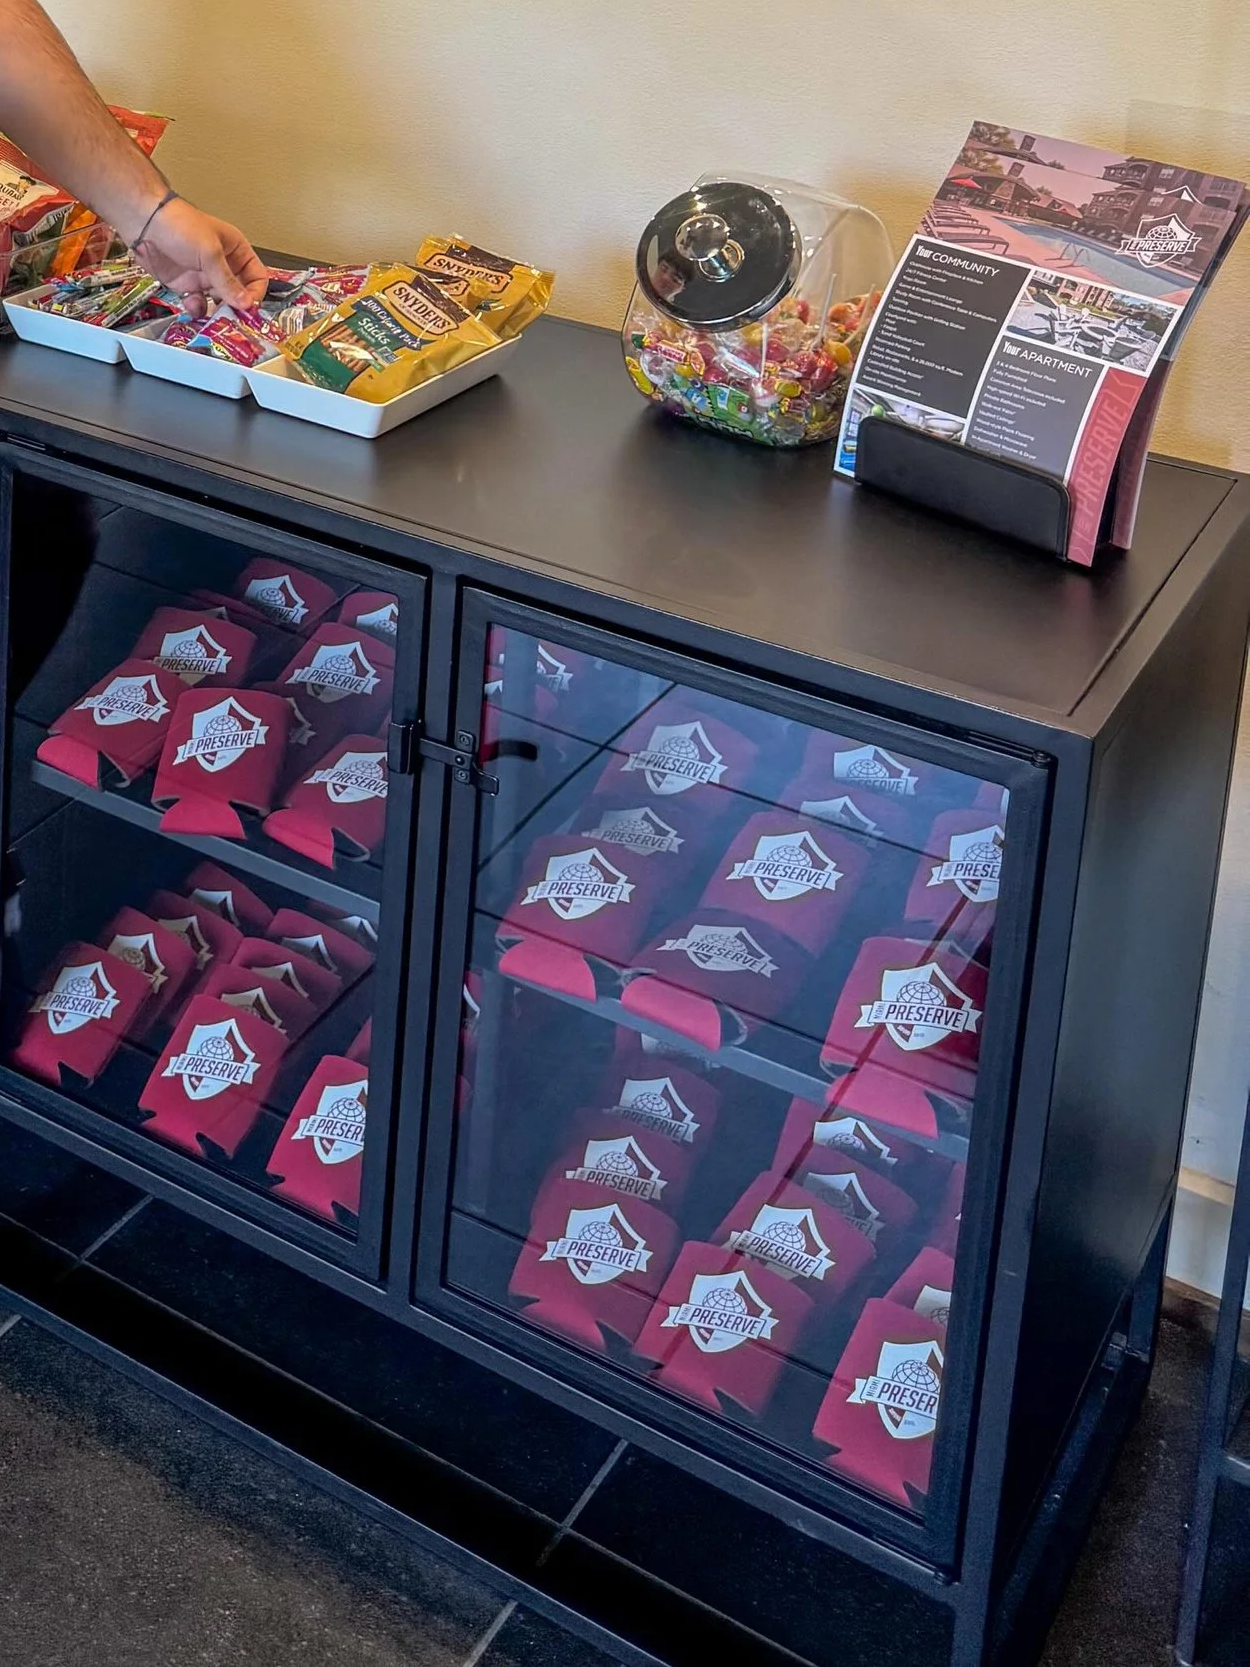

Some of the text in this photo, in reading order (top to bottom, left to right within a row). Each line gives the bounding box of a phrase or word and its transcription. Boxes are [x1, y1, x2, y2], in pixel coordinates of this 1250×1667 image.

[1136, 241, 1188, 252] PRESERVE
[916, 245, 999, 276] Your COMMUNITY
[358, 317, 390, 345] Sticks
[1003, 341, 1092, 377] Your APARTMENT
[1076, 399, 1127, 517] PRESERVE
[161, 659, 215, 674] PRESERVE
[310, 669, 363, 692] PRESERVE
[99, 695, 153, 718] PRESERVE
[195, 731, 255, 753] PRESERVE
[646, 752, 709, 781] PRESERVE
[604, 830, 667, 850] PRESERVE
[755, 862, 825, 886] PRESERVE
[954, 861, 1000, 880] PRESE
[548, 881, 618, 900] PRESERVE
[687, 940, 760, 970] PRESERVE
[51, 994, 102, 1017] PRESERVE
[885, 1003, 963, 1030] PRESERVE
[184, 1056, 243, 1082] PRESERVE
[316, 1117, 363, 1142] PRESER
[587, 1171, 652, 1198] PRESERVE
[568, 1240, 636, 1268] PRESERVE
[750, 1235, 817, 1275] PRESERVE
[691, 1306, 761, 1336] PRESERVE
[877, 1381, 938, 1413] PRESER
